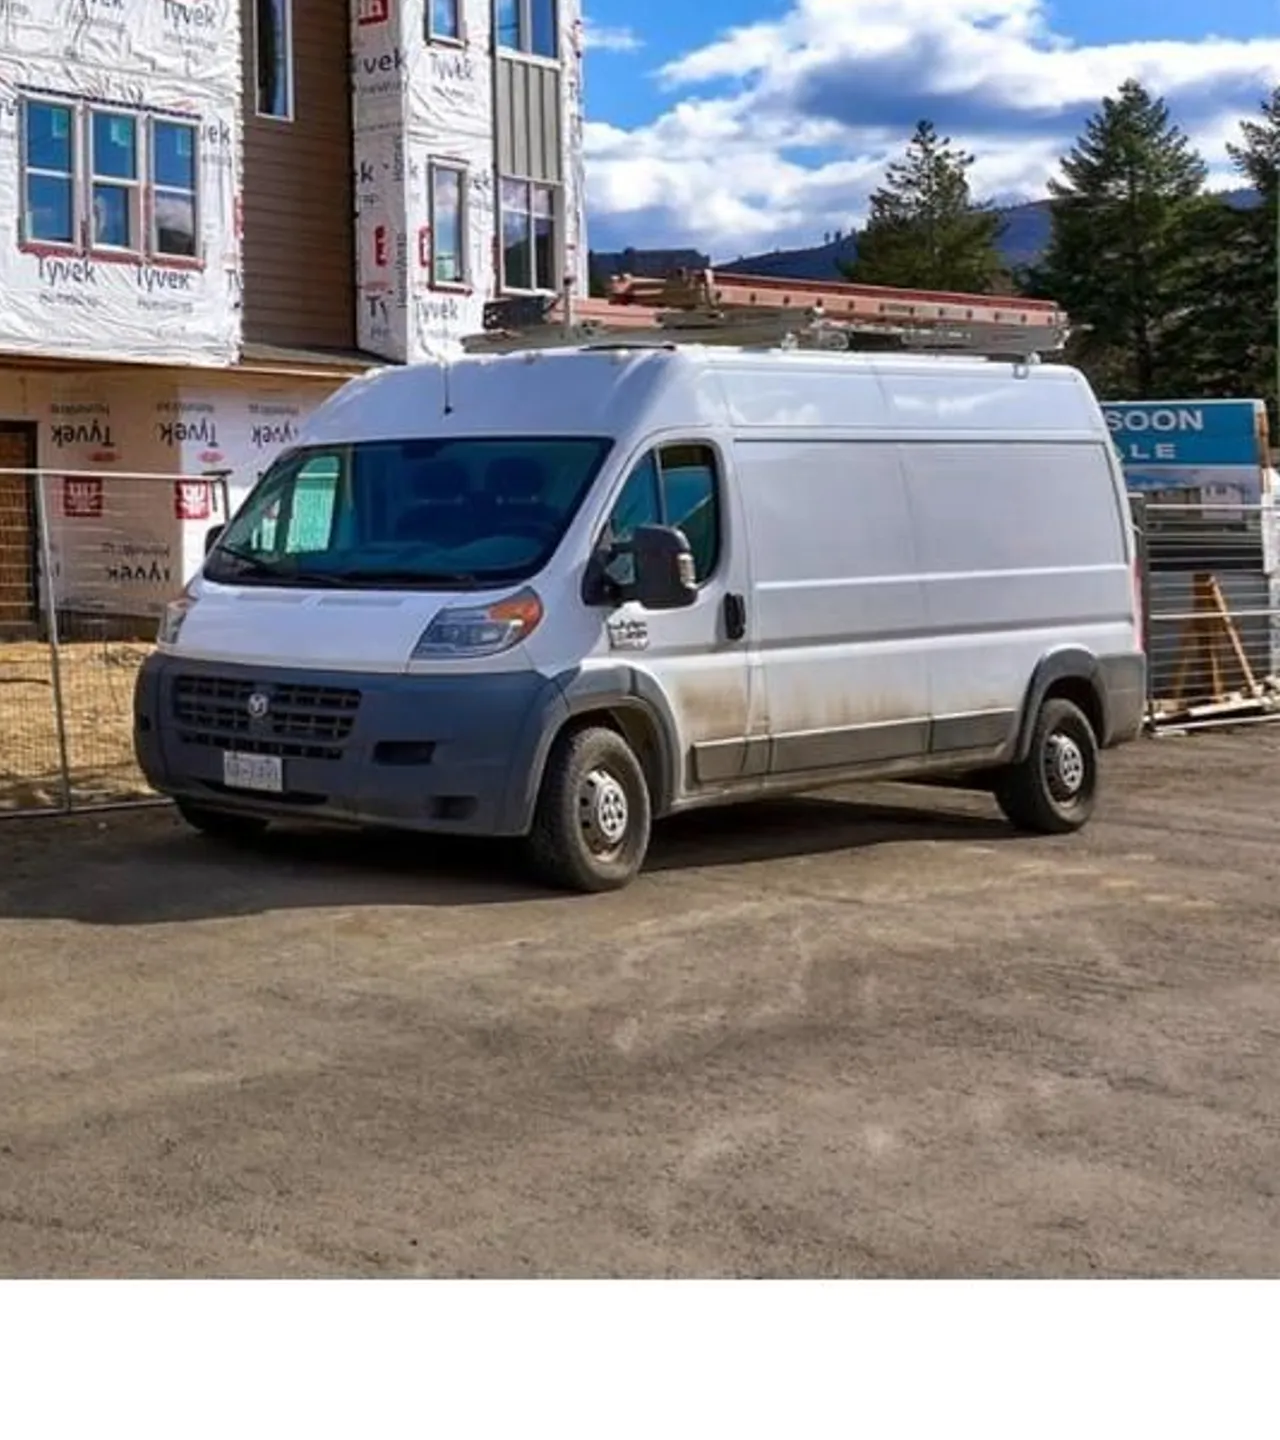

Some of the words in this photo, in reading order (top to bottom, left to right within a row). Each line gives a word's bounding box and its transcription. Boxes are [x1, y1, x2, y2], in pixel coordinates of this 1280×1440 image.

[159, 418, 219, 448] Tyvek
[1104, 409, 1204, 431] SOON
[51, 421, 115, 448] Tyvek
